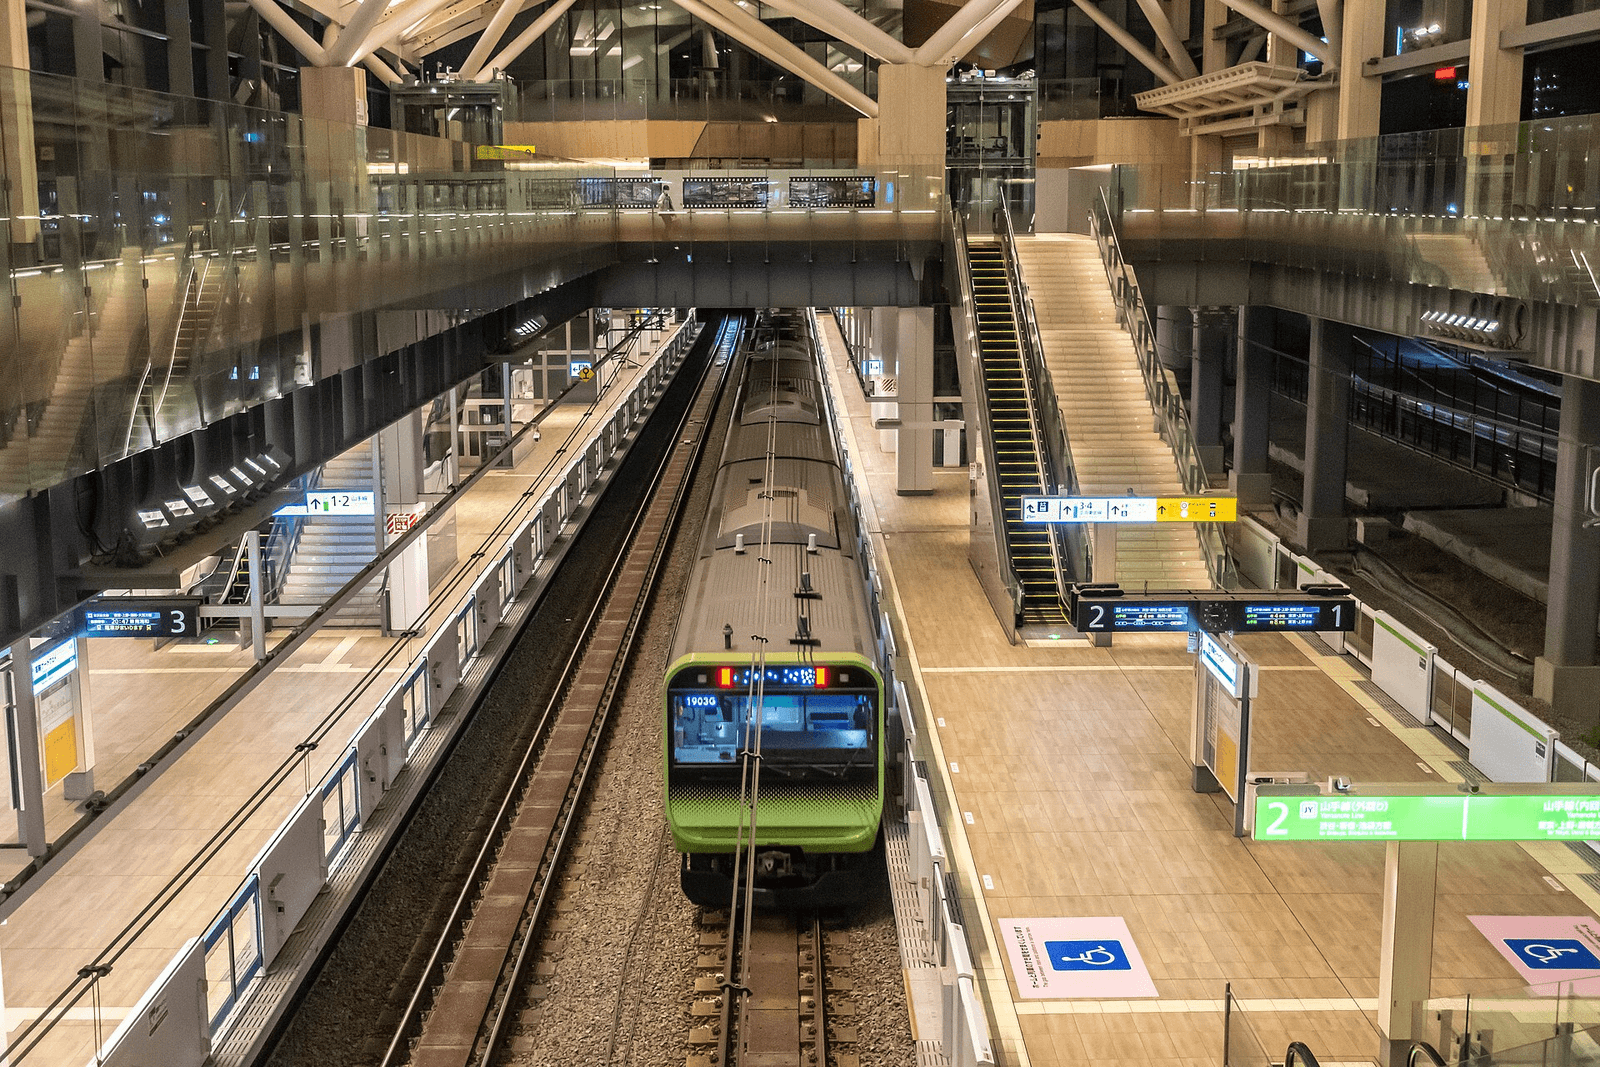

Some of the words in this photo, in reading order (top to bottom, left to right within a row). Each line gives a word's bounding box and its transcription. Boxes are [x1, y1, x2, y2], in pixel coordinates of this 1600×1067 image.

[170, 610, 186, 633] 3
[1089, 606, 1104, 628] 2
[1332, 605, 1340, 627] 1
[686, 697, 716, 706] 1903G
[1266, 802, 1289, 835] 2
